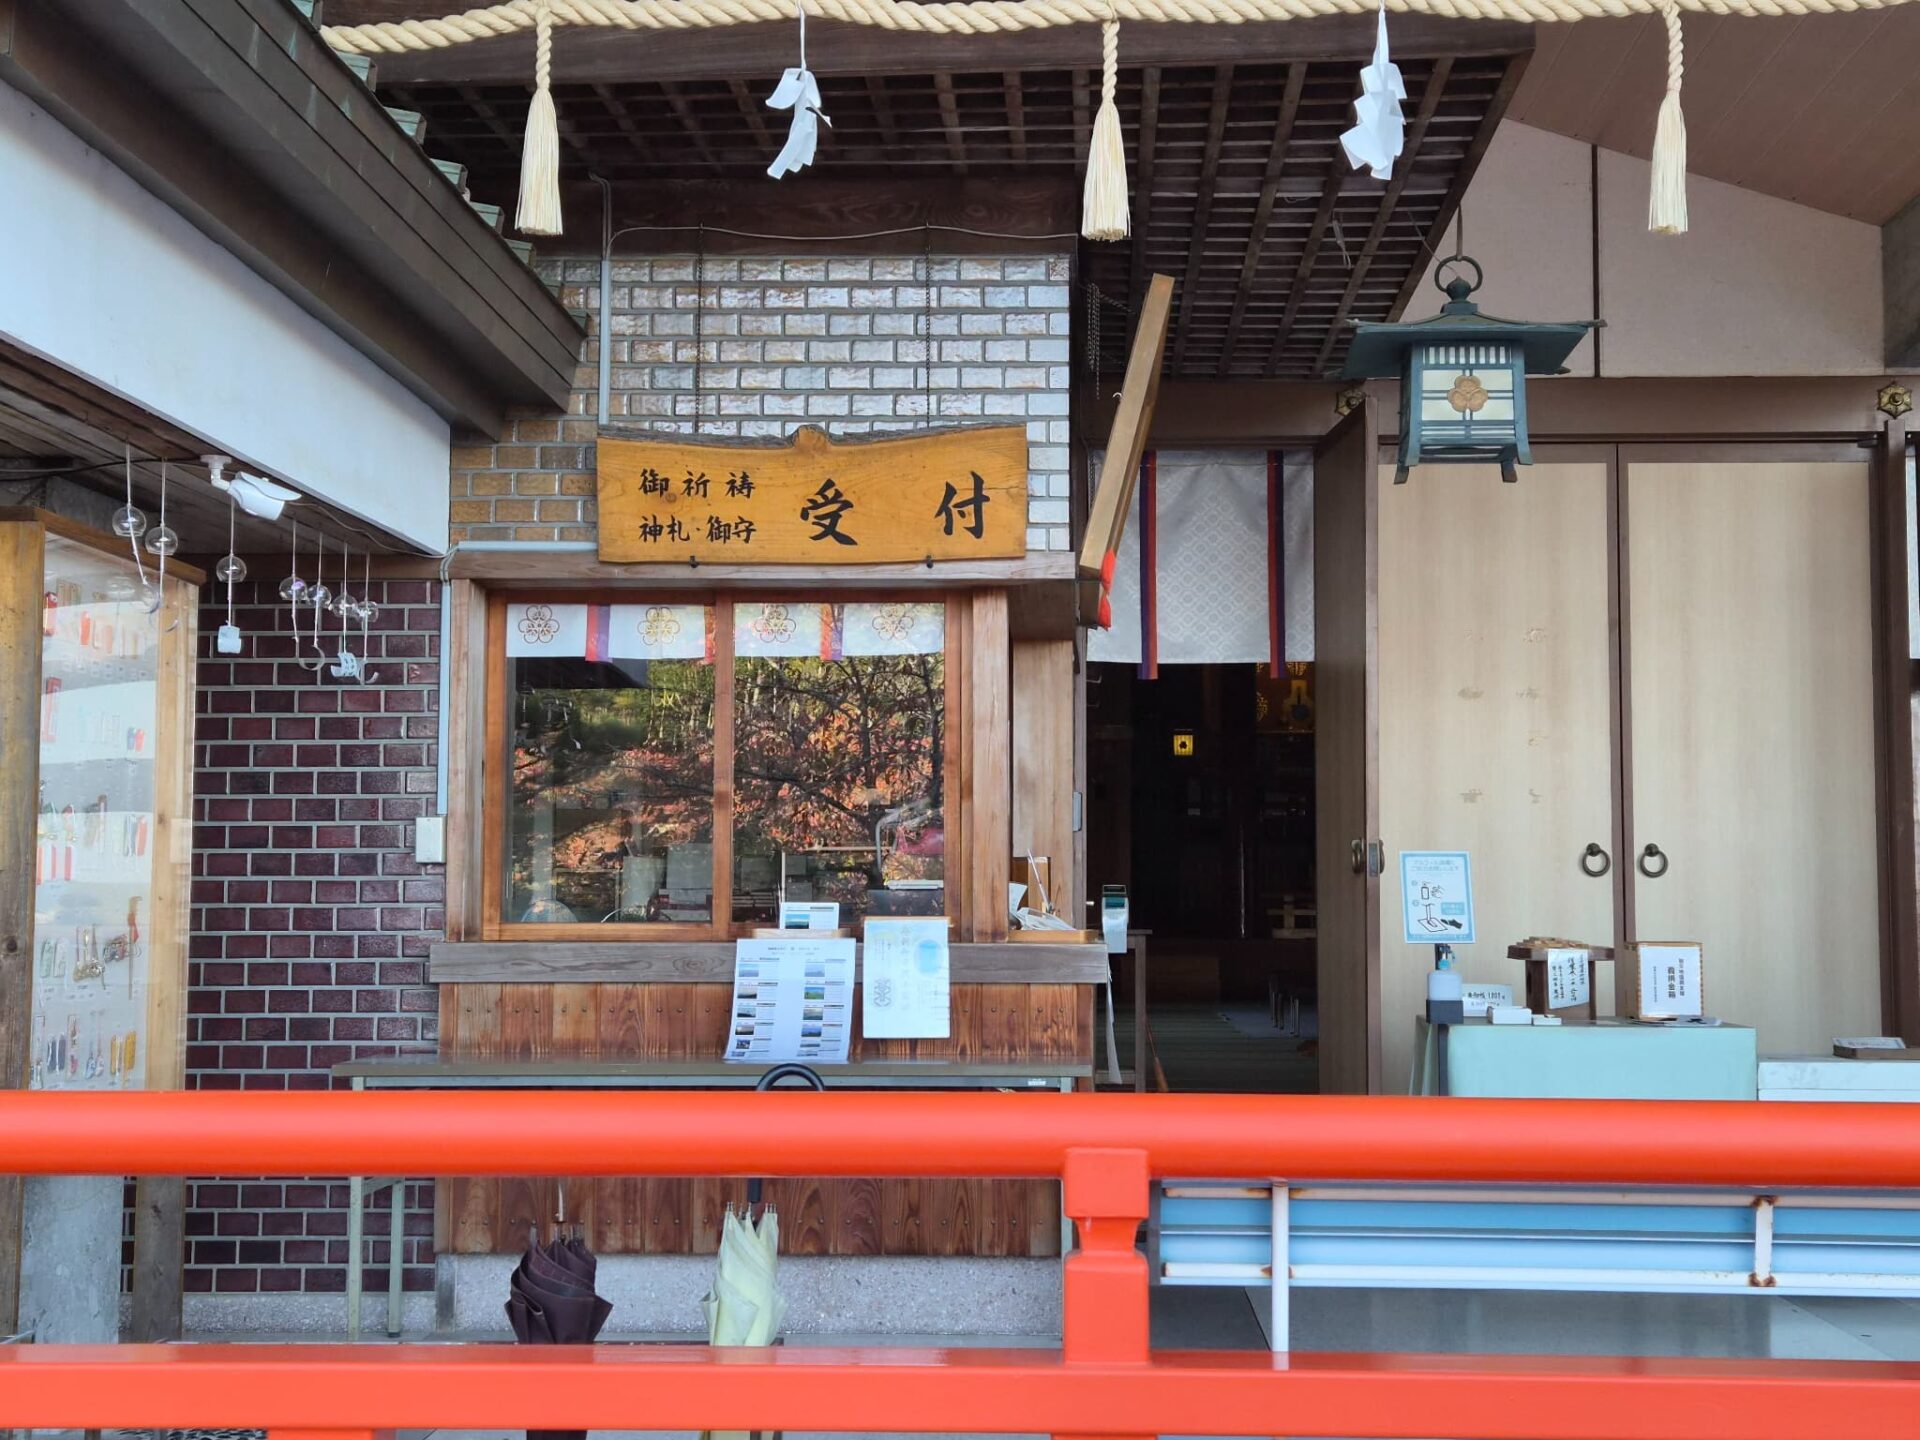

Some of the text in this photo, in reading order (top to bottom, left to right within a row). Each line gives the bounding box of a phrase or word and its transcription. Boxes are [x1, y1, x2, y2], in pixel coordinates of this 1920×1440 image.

[638, 468, 756, 499] 御祈祷
[799, 470, 991, 546] 受付
